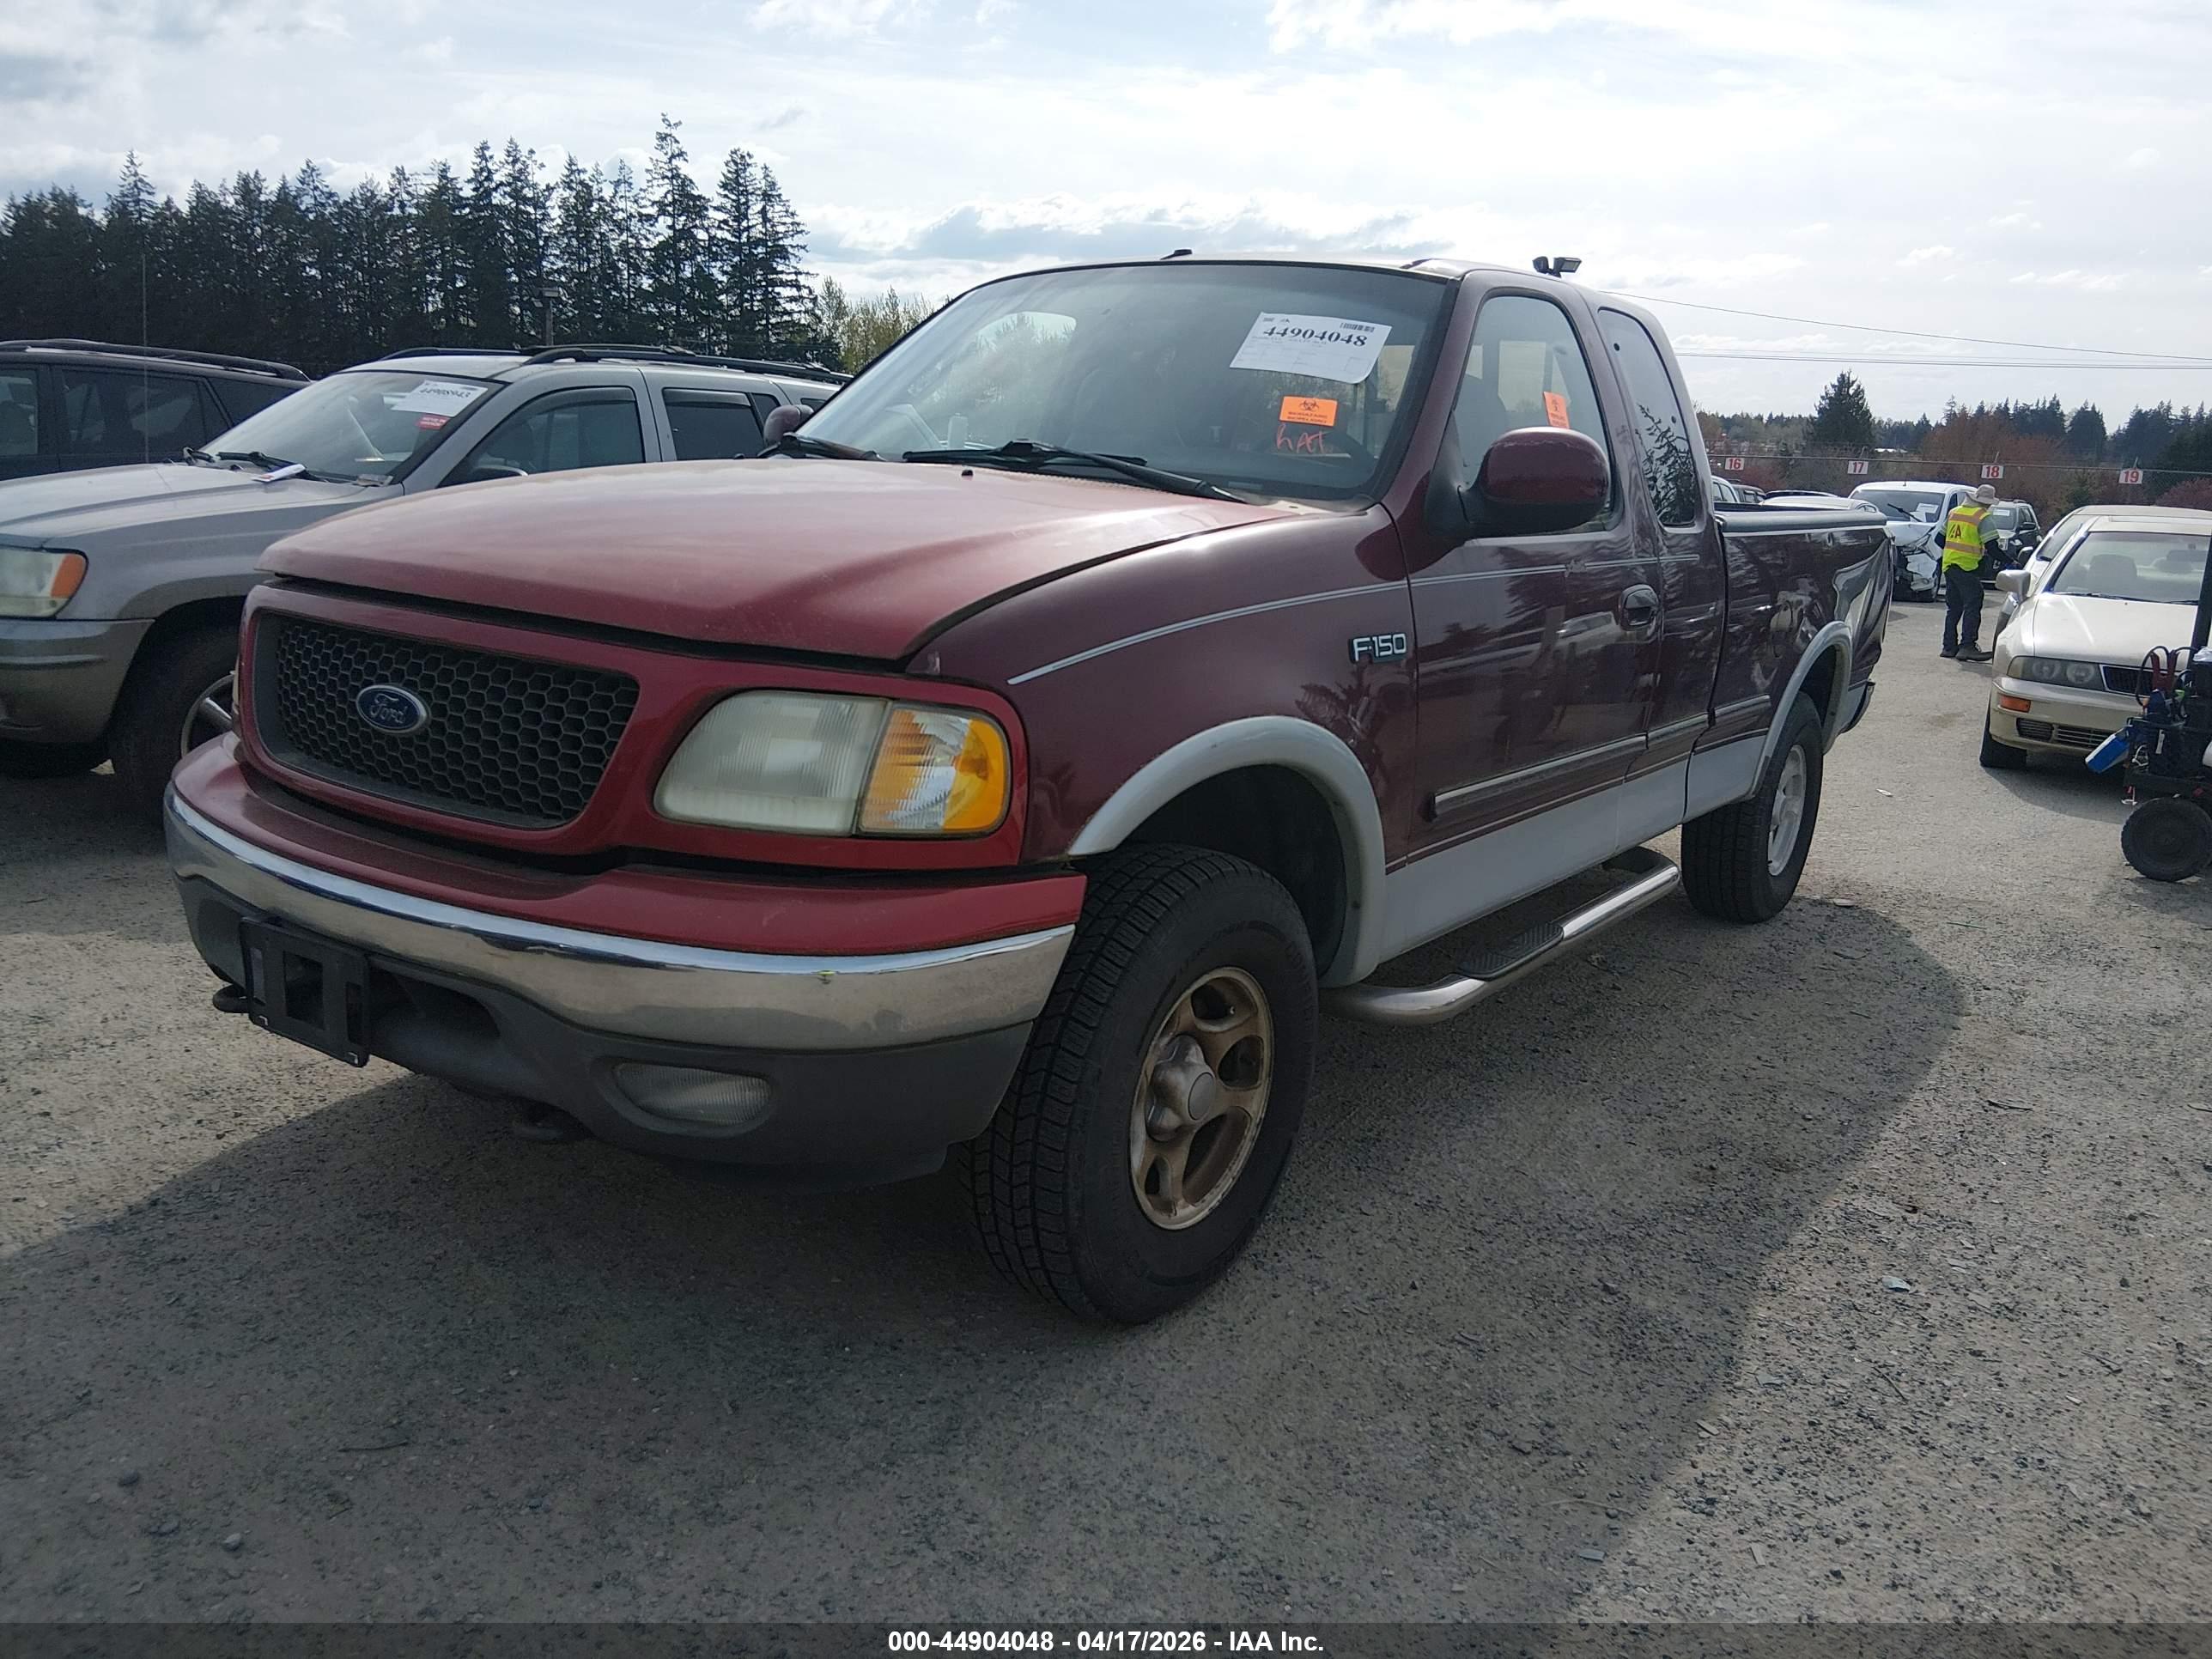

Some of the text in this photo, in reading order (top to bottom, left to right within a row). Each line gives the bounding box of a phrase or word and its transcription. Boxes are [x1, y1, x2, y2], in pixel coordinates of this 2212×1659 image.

[1263, 326, 1368, 346] 44904048
[1729, 459, 1741, 469] 16
[1852, 462, 1865, 473] 17
[1985, 466, 2000, 477] 18
[2124, 471, 2139, 483] 19
[370, 693, 408, 724] Ford
